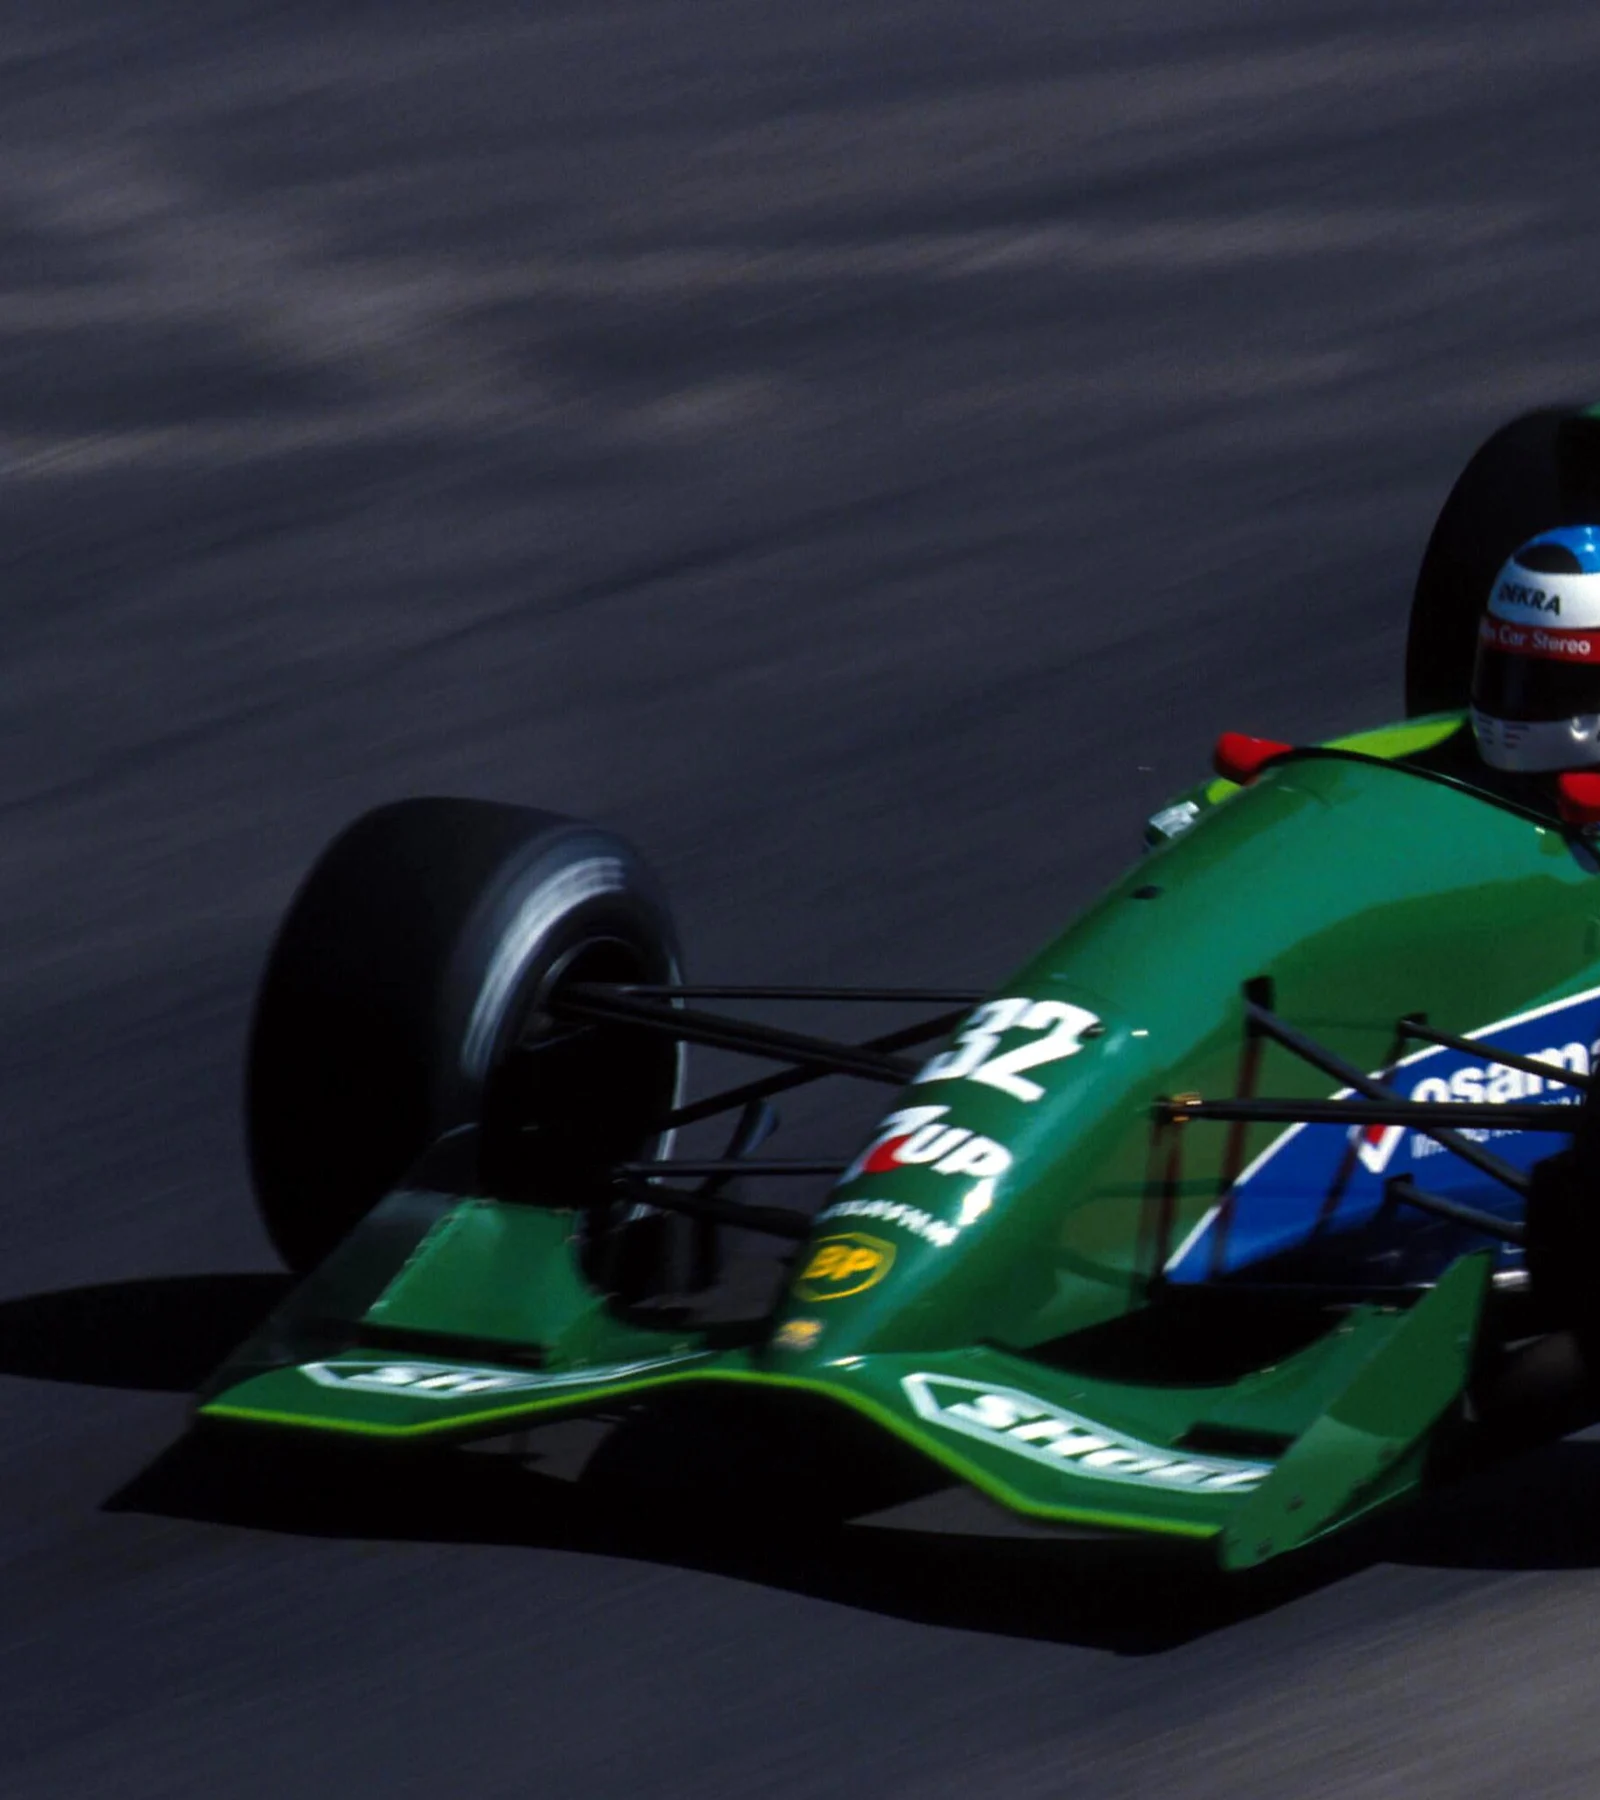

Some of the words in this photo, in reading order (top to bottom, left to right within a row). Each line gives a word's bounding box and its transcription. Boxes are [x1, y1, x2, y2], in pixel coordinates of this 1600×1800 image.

[1532, 629, 1591, 655] Stereo
[912, 997, 1101, 1103] 32
[802, 1245, 885, 1281] BP
